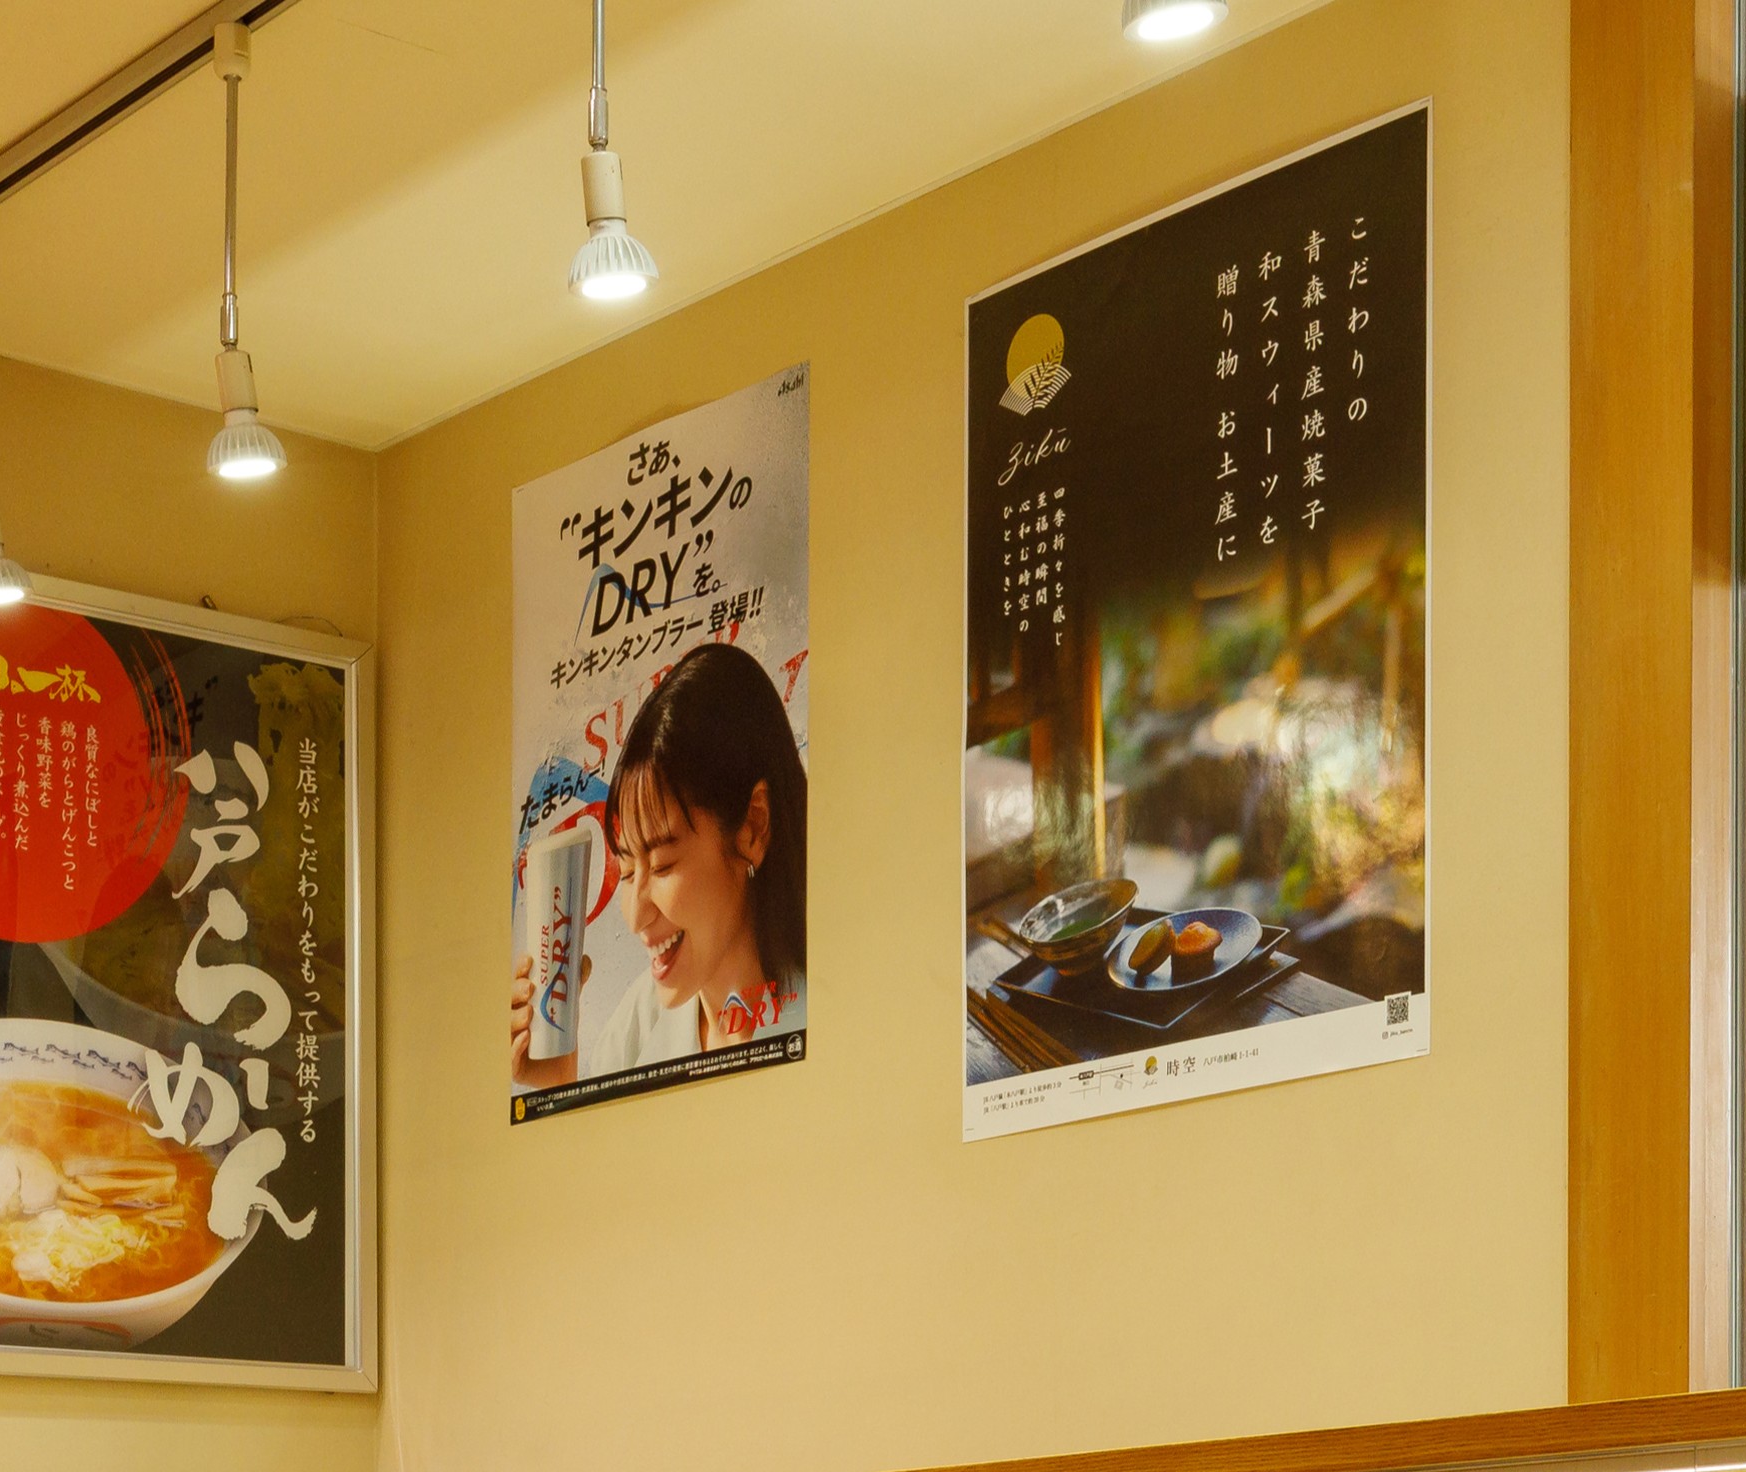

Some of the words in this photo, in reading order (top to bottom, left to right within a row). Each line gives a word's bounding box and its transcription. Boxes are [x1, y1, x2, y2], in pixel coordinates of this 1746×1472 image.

[1215, 264, 1240, 381] 贈り物
[1300, 229, 1327, 531] 青森県産焼菓子
[1347, 216, 1370, 422] こだわりの
[777, 373, 805, 398] Asahi
[1257, 250, 1283, 546] 和スウィーツを
[627, 440, 682, 487] さあ、
[1215, 410, 1239, 562] お土産に
[1003, 505, 1014, 616] ひとときを
[1018, 500, 1031, 632] 心和む時空の
[1035, 491, 1049, 606] 至福の瞬間
[1052, 486, 1066, 646] 四季折々を感じ
[13, 712, 29, 851] じっくり煮込んだ
[36, 716, 54, 809] 香味野菜を
[60, 720, 77, 892] 鶏のがらとげんこつと
[84, 724, 101, 848] 良質なにぼしと
[127, 740, 318, 1241] 八戸らーめん
[296, 738, 321, 1144] 当店がこだわりをもって提供する
[540, 925, 550, 986] SUPER
[1166, 1056, 1197, 1078] 時空
